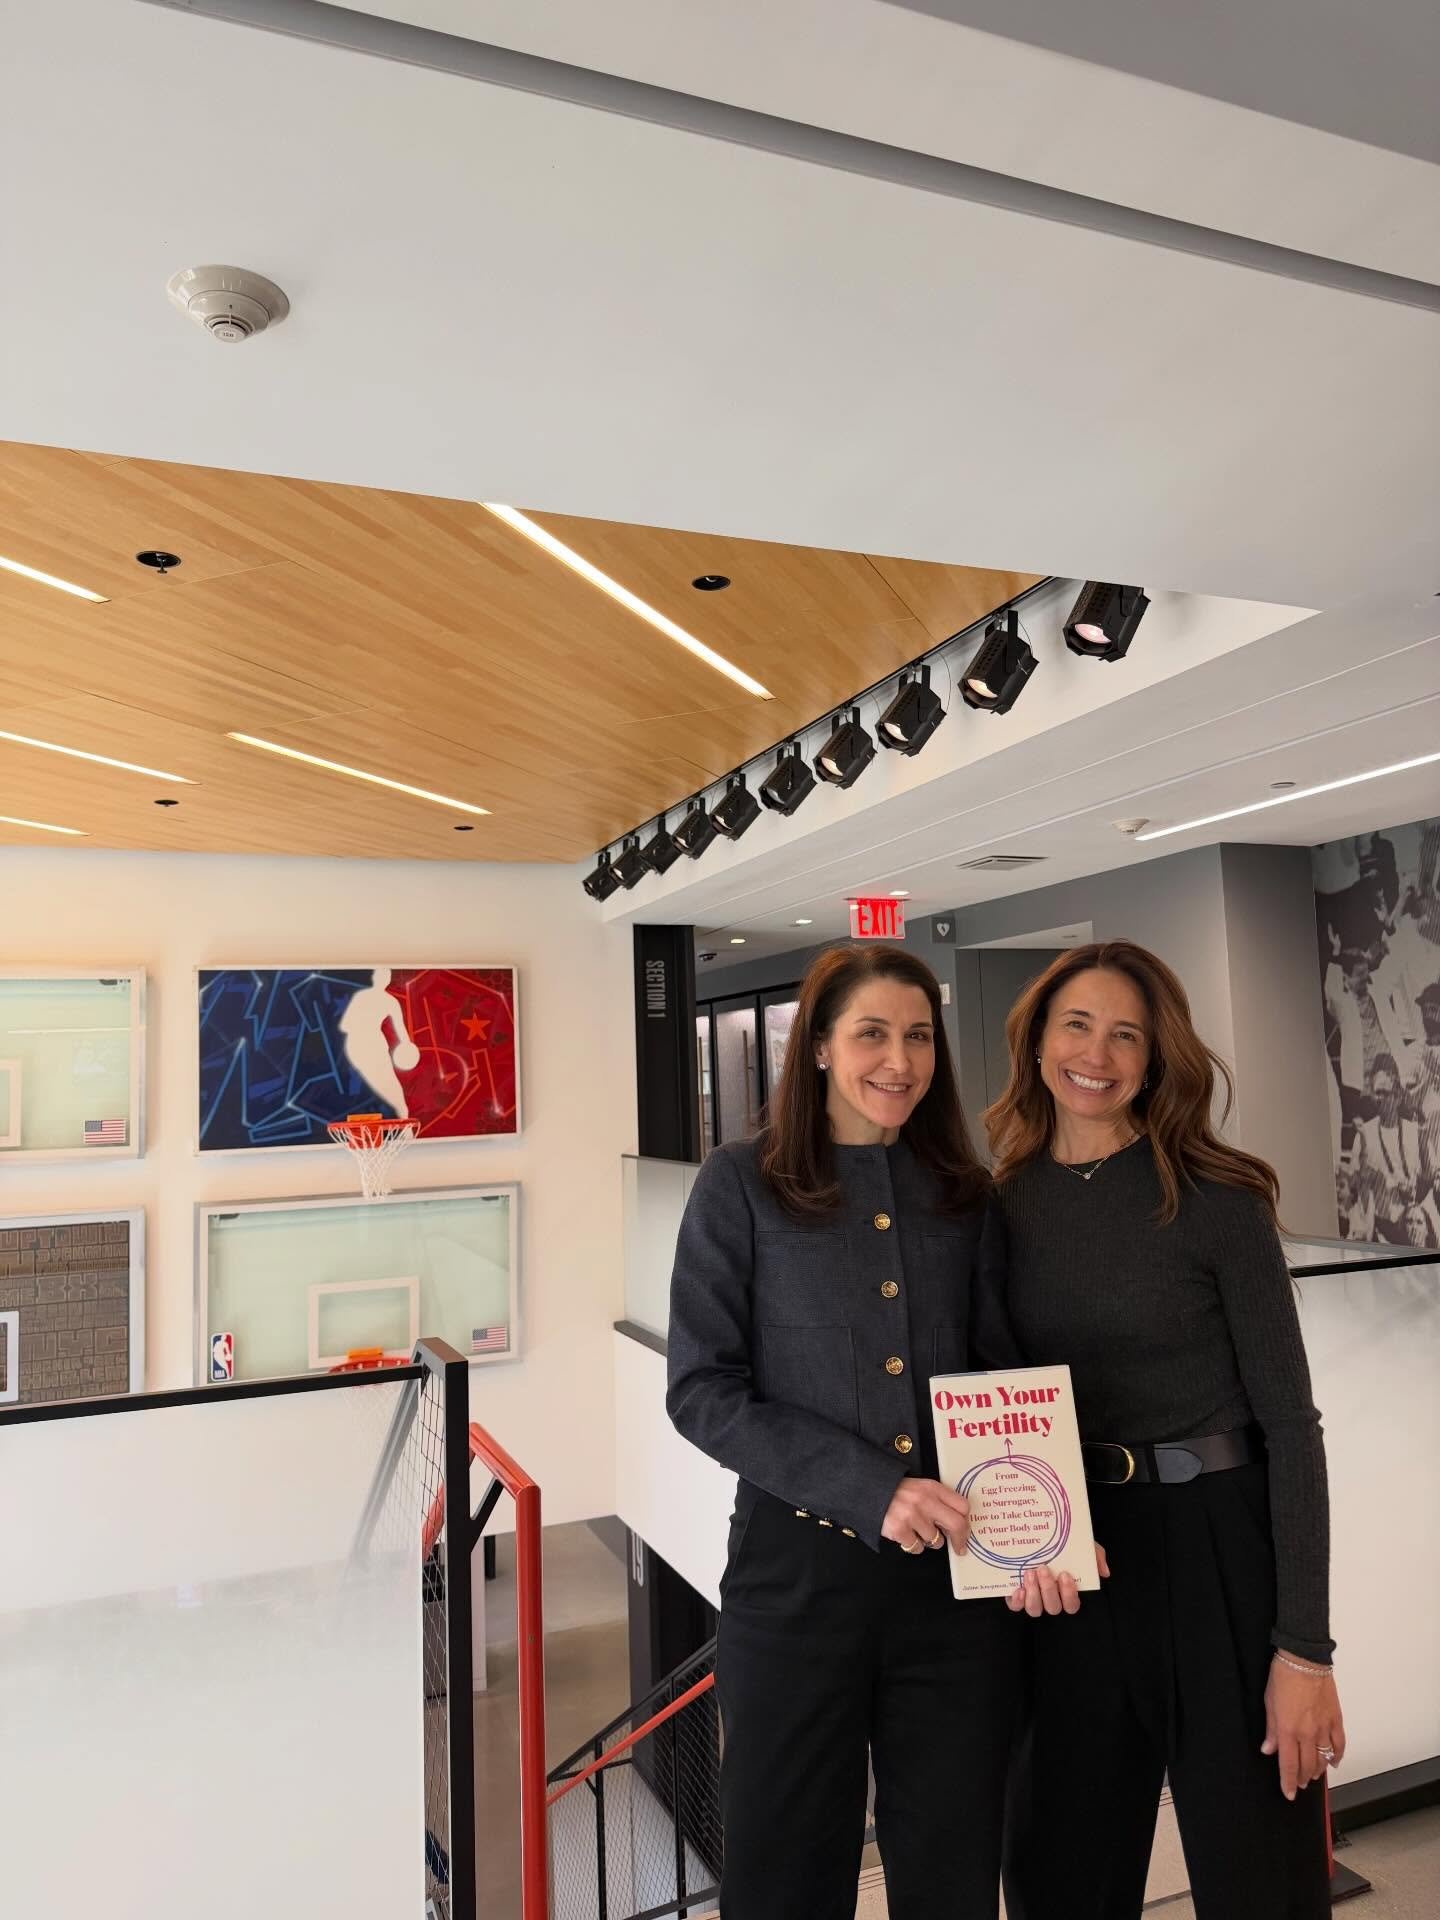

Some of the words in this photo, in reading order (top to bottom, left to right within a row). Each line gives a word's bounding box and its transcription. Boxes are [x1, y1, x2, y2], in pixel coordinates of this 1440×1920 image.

[856, 898, 898, 937] EXIT
[645, 960, 666, 1009] SECTION
[934, 1390, 993, 1411] Own
[995, 1385, 1060, 1407] Your
[948, 1411, 1053, 1439] Fertility
[995, 1472, 1019, 1480] From
[981, 1486, 998, 1495] Egg
[999, 1484, 1037, 1493] Freezing
[992, 1497, 1039, 1507] Surrogacy,
[970, 1513, 989, 1522] How
[990, 1512, 1000, 1520] to
[1001, 1511, 1022, 1520] Take
[1023, 1508, 1054, 1518] Charge
[977, 1526, 987, 1535] of
[987, 1525, 1009, 1534] Your
[1009, 1523, 1032, 1533] Body
[1033, 1521, 1050, 1530] and
[990, 1539, 1010, 1548] Your
[1011, 1537, 1041, 1546] Future
